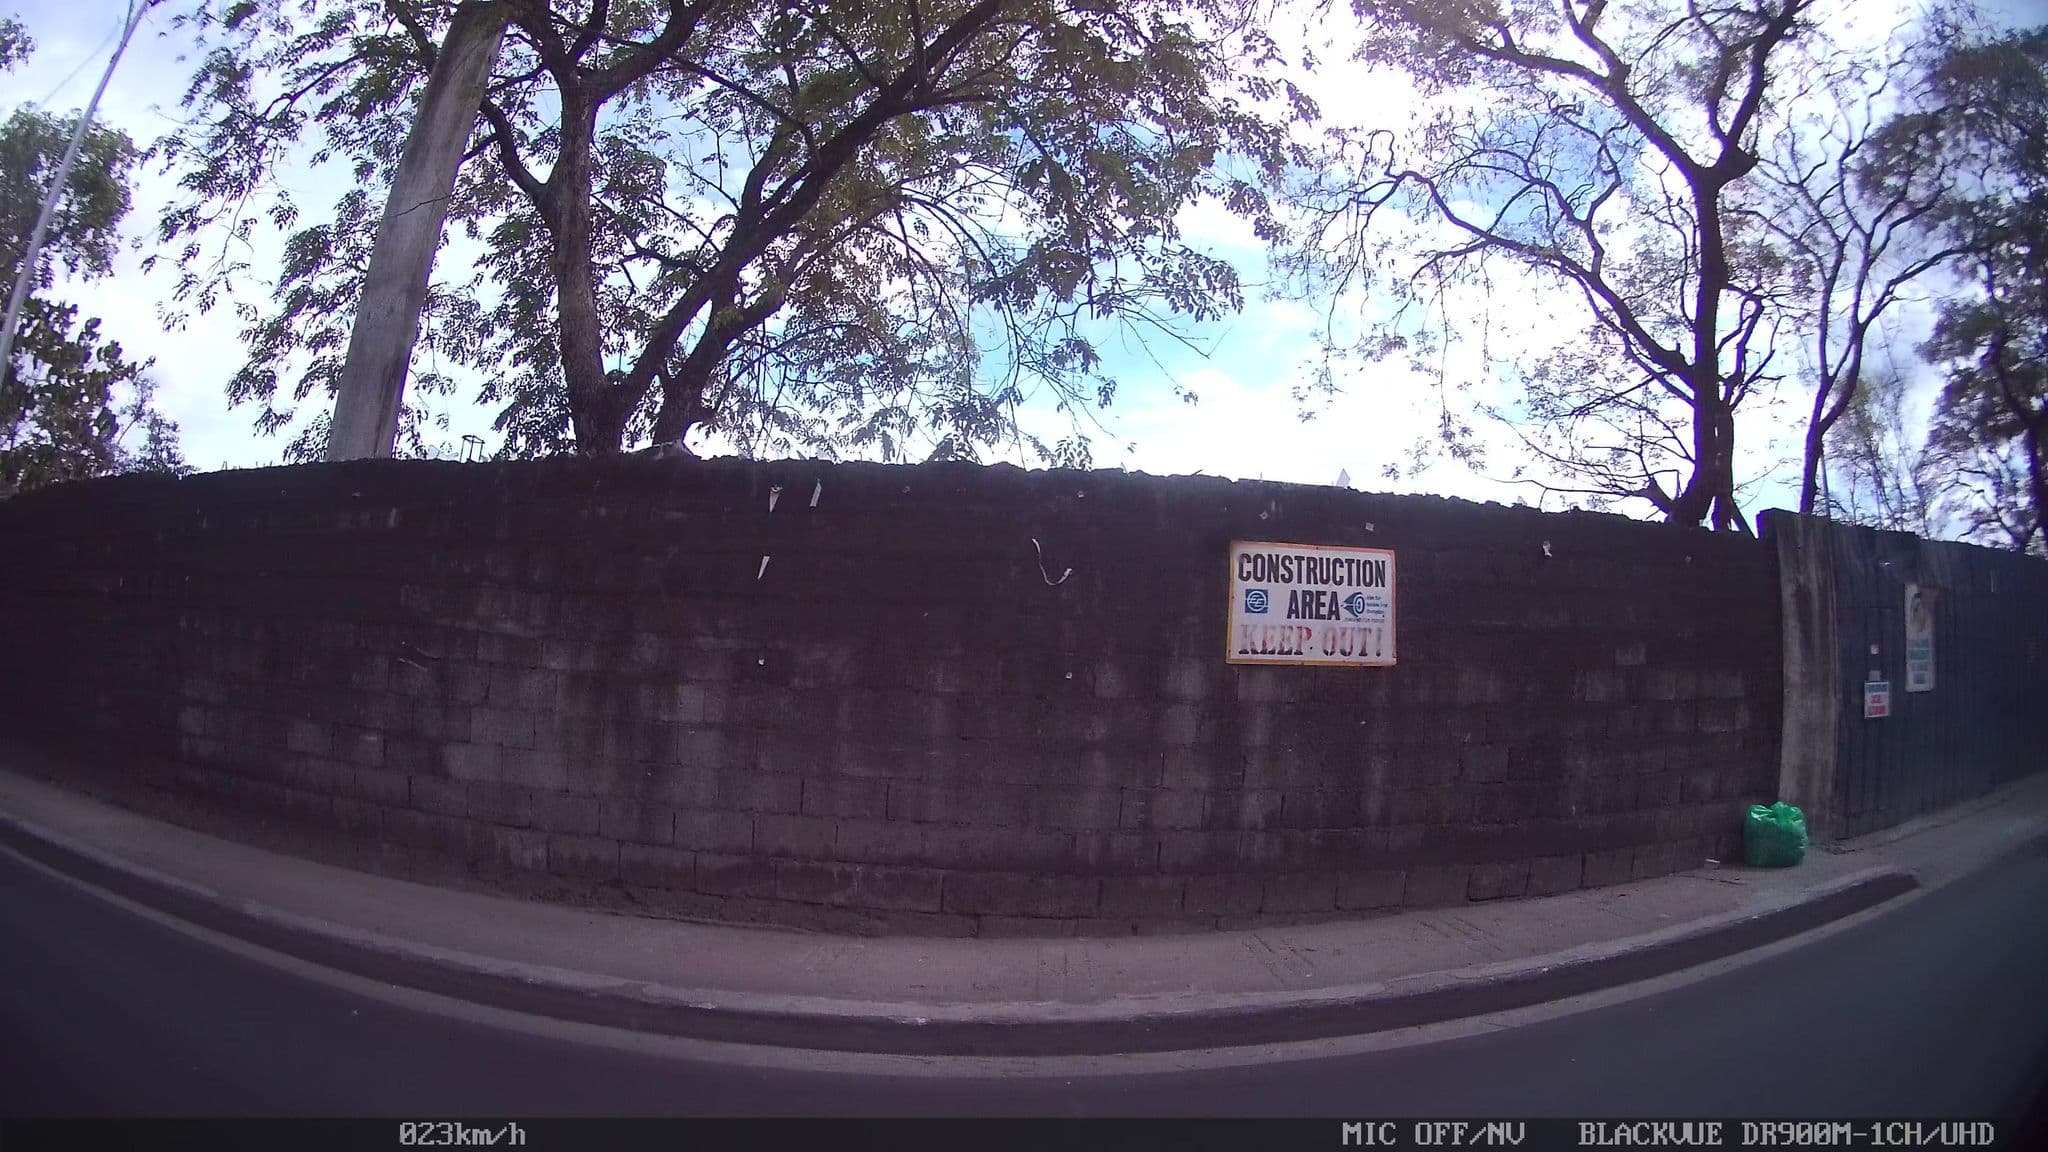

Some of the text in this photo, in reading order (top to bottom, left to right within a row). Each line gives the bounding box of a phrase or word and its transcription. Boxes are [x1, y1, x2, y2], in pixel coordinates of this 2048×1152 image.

[1238, 553, 1386, 588] CONSTRUCTION
[1286, 589, 1341, 621] AREA
[1238, 624, 1384, 658] KEEP OUT!
